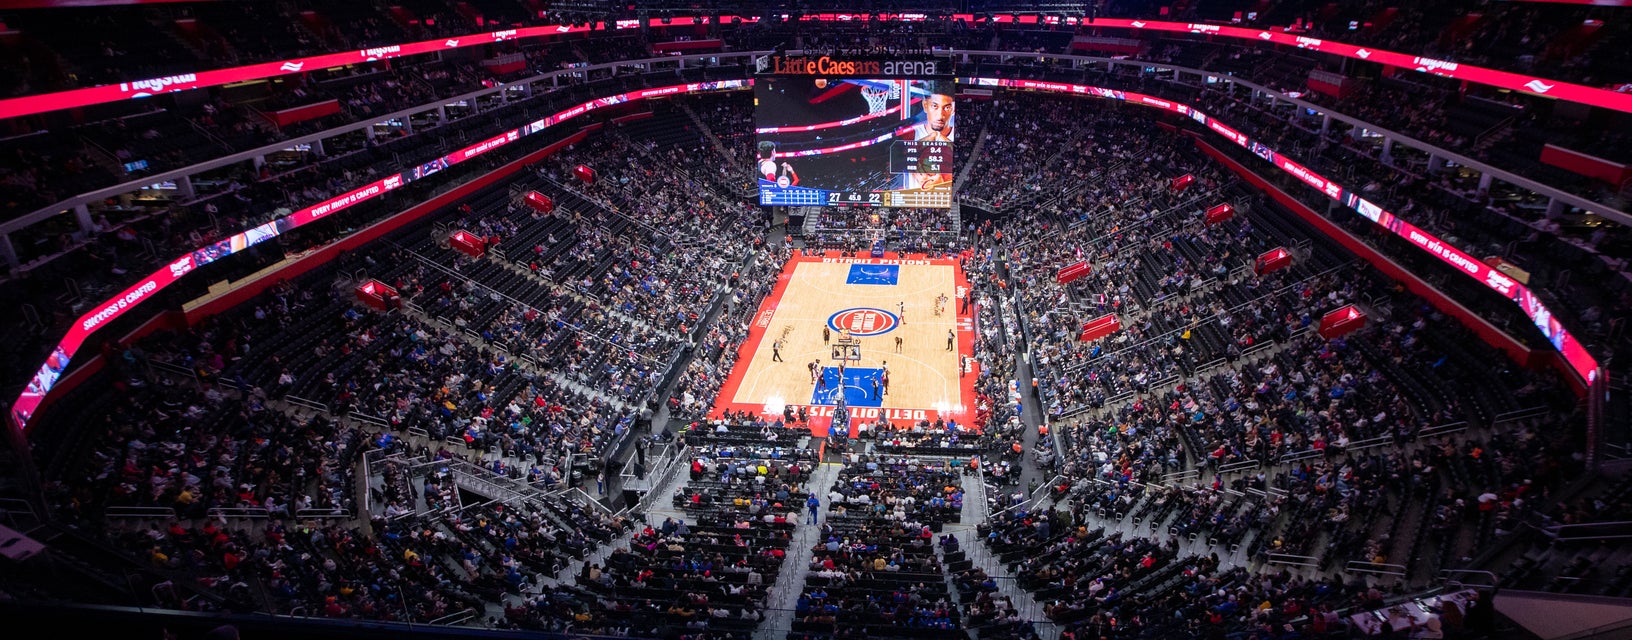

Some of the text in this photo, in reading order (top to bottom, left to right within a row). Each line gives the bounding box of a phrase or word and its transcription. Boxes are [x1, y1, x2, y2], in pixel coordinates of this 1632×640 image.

[773, 56, 816, 74] Little
[818, 56, 880, 74] Caesars
[884, 61, 936, 75] arena
[311, 204, 331, 218] EVERY
[350, 194, 357, 203] IS
[356, 186, 379, 200] CRAFTED
[829, 192, 841, 203] 27
[868, 193, 880, 203] 22
[1410, 231, 1429, 247] EVERY
[1449, 253, 1479, 274] CRAFTED
[117, 298, 128, 309] IS
[125, 280, 156, 304] CRAFTED
[955, 285, 968, 299] Jeep
